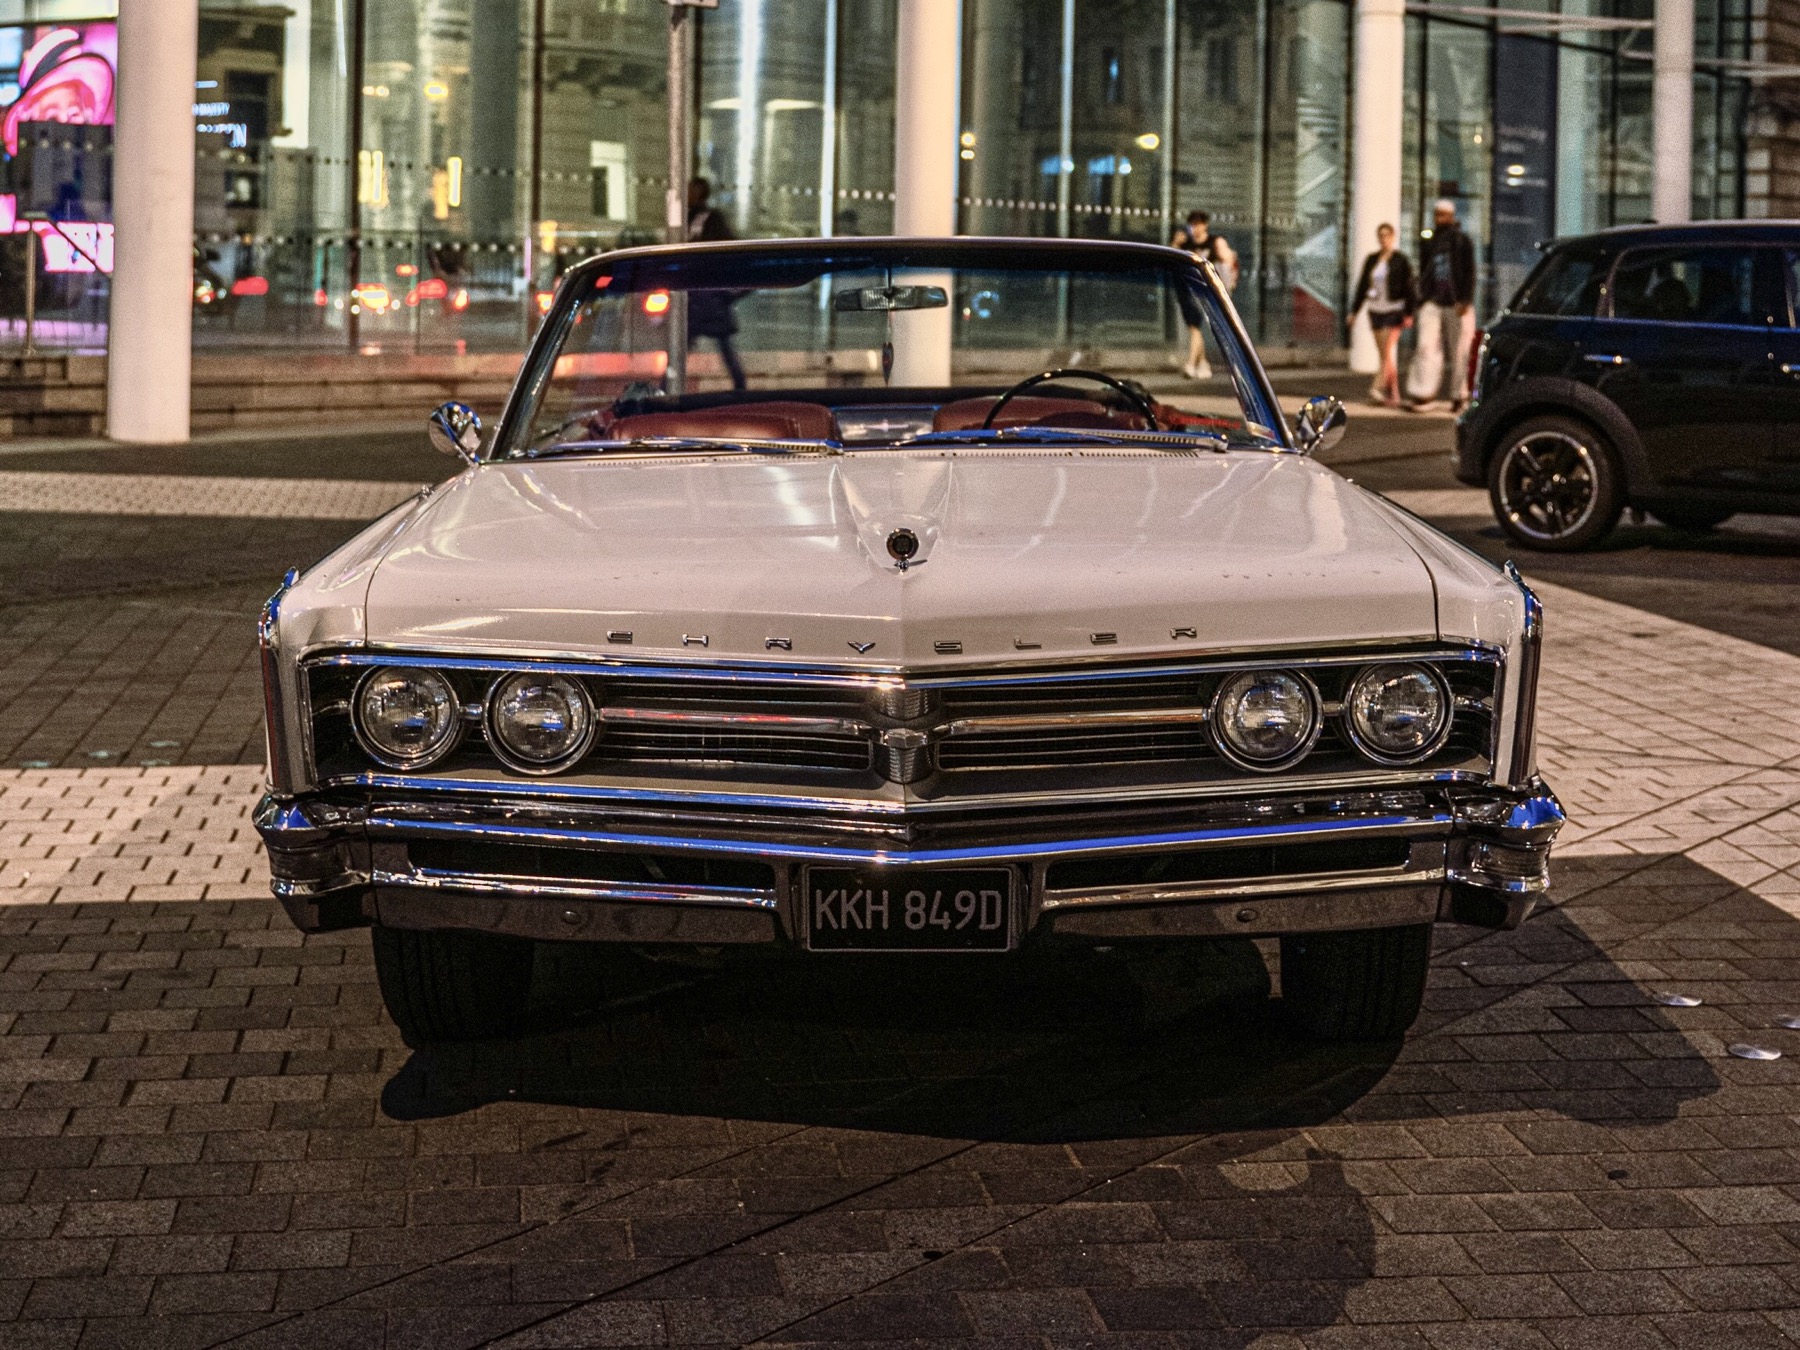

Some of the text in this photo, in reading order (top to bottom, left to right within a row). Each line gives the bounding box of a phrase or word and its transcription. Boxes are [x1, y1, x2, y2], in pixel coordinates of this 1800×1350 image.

[606, 627, 1197, 653] CHRYSLER
[815, 889, 1002, 930] KKH 849D
